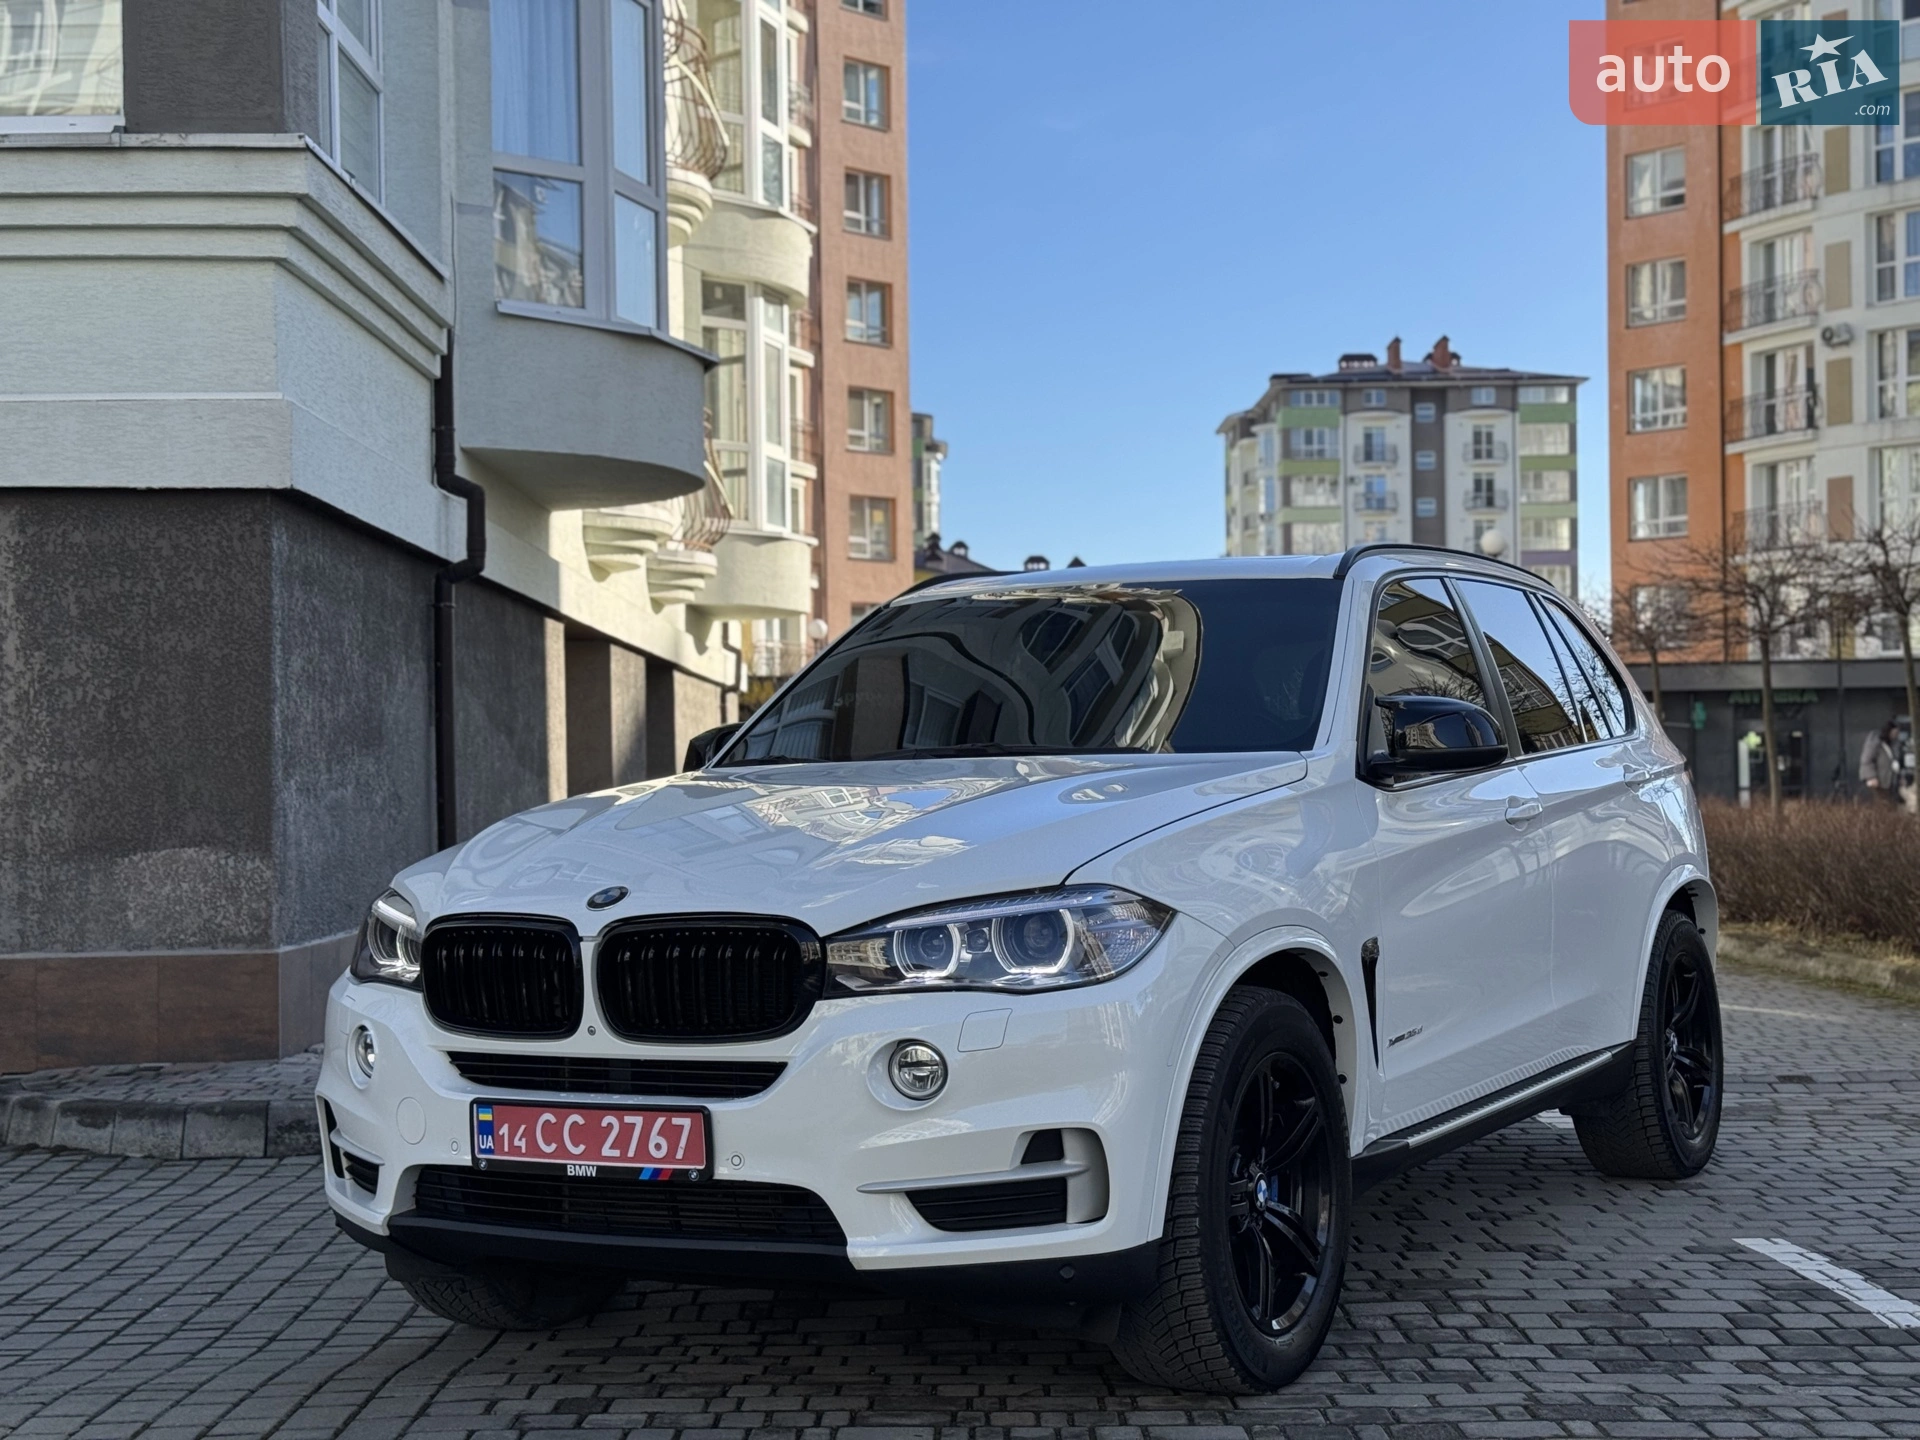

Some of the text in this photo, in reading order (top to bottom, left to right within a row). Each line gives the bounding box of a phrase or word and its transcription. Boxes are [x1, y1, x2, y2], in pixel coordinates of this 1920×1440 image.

[478, 1134, 494, 1150] UA
[498, 1112, 692, 1160] 14 CC 2767
[567, 1164, 597, 1178] BMW
